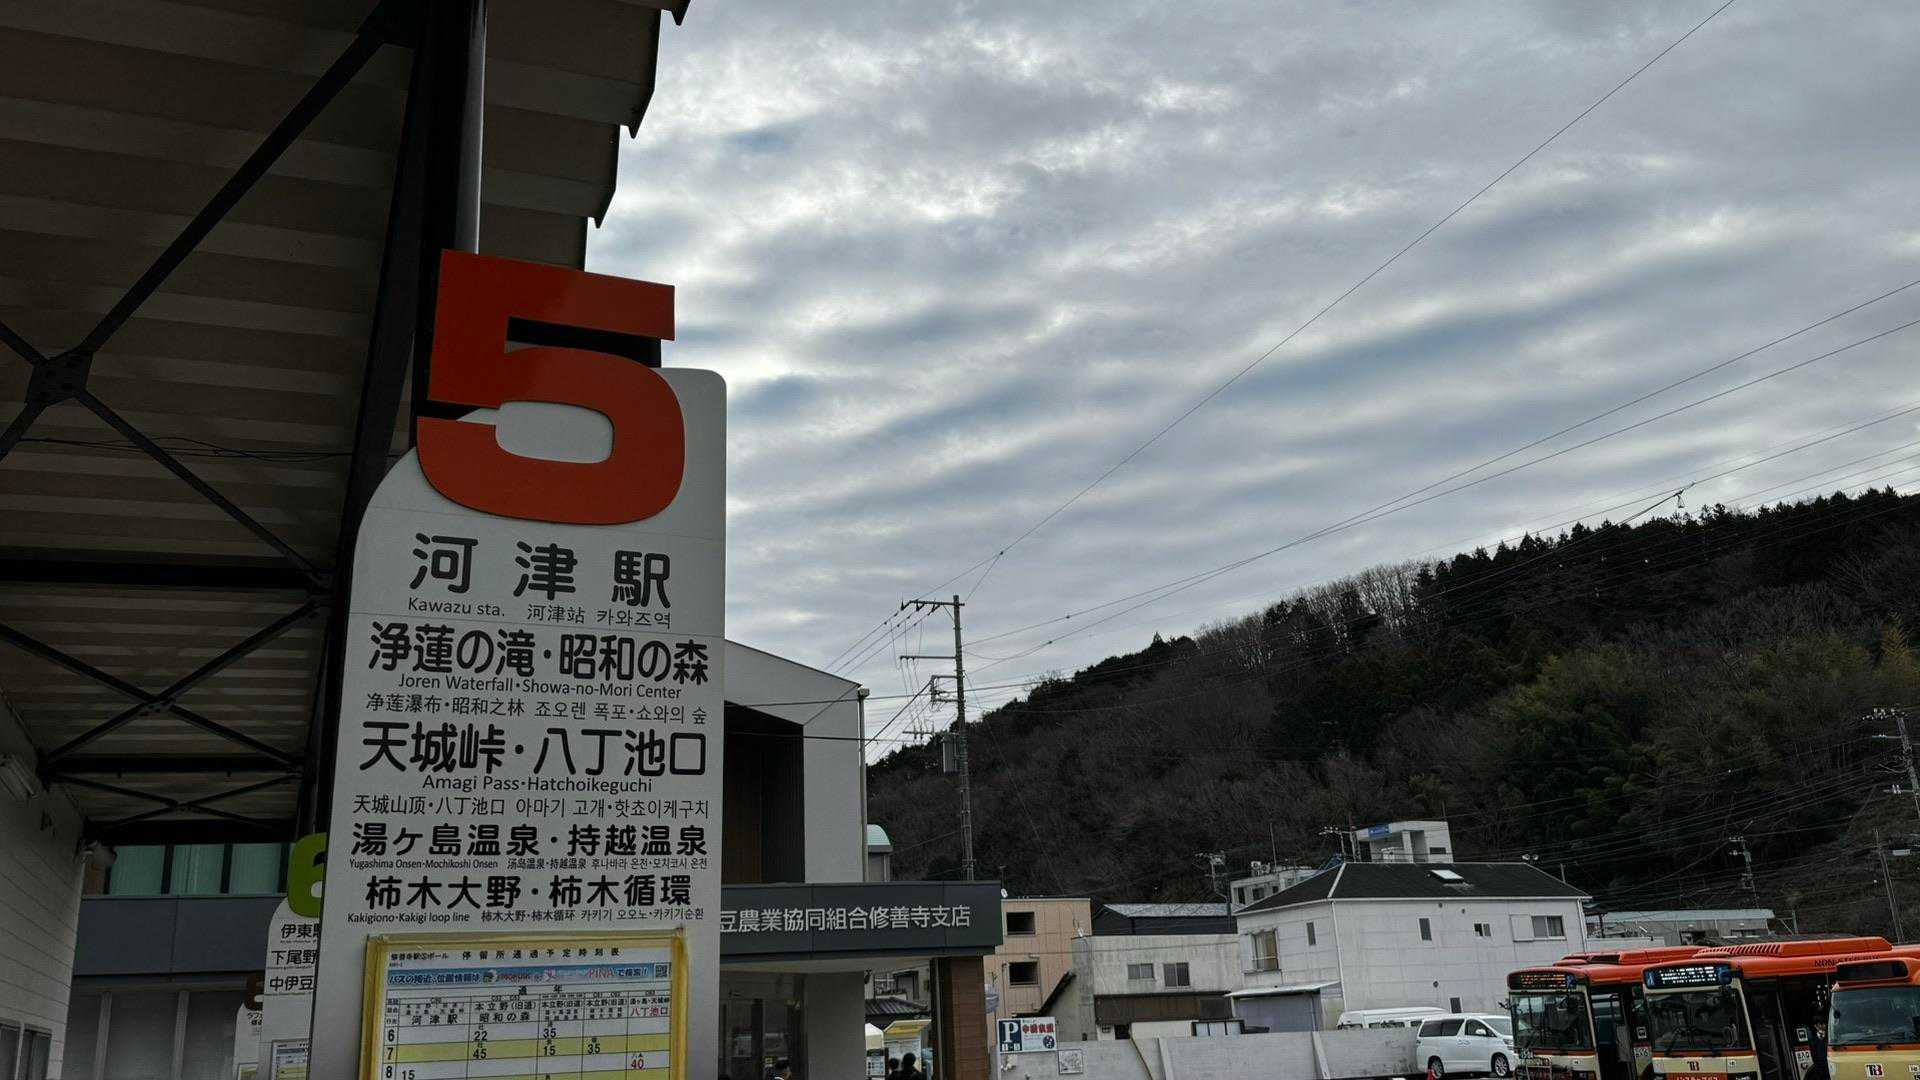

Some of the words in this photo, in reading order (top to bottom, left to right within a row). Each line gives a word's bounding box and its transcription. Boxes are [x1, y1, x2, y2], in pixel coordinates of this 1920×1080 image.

[416, 249, 685, 525] 5
[409, 533, 671, 608] 河津駅
[408, 597, 472, 615] Kawazu
[476, 602, 505, 616] sta.
[527, 603, 586, 623] 河津站
[597, 609, 672, 629] 카와즈역
[399, 674, 440, 689] Joren
[636, 684, 681, 699] Center
[692, 706, 707, 725] 숲
[359, 722, 707, 777] 天城峠・八丁池口
[422, 775, 479, 792] Amagi
[515, 798, 566, 818] 아마기
[349, 858, 393, 870] Yugashima
[473, 859, 498, 869] Onsen
[365, 874, 692, 910] 柿木大野・柿木循環
[429, 912, 451, 924] loop
[453, 912, 470, 922] line
[387, 1029, 395, 1042] 6
[473, 1030, 488, 1042] 22
[543, 1027, 557, 1039] 35
[1003, 1021, 1019, 1043] P
[387, 1047, 394, 1060] 7
[472, 1048, 487, 1059] 45
[543, 1045, 556, 1056] 15
[587, 1043, 601, 1055] 35
[385, 1065, 393, 1079] 8
[401, 1069, 415, 1080] 15
[630, 1058, 645, 1070] 40
